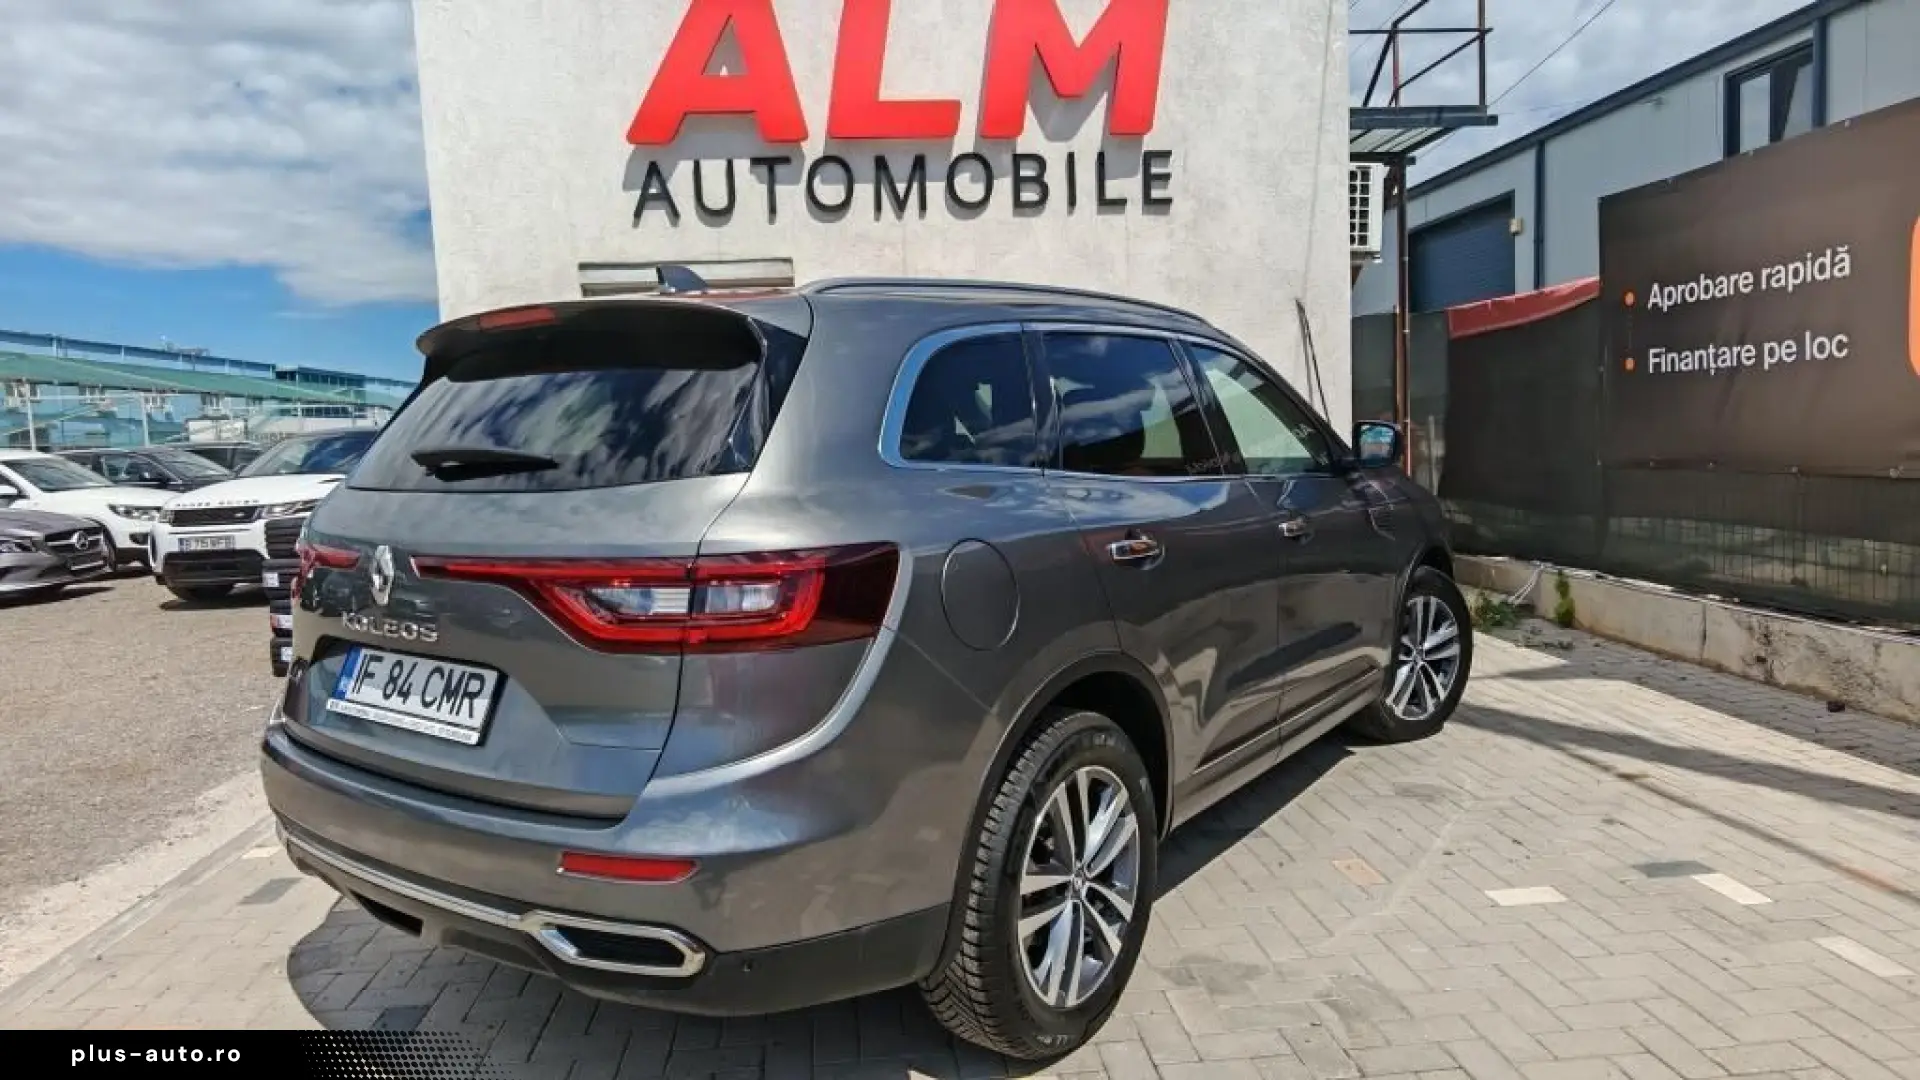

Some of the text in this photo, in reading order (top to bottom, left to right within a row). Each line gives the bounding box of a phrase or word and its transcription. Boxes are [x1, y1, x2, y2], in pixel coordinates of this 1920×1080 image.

[626, 0, 1169, 144] ALM
[633, 150, 1173, 221] AUTOMOBILE
[1647, 245, 1852, 312] Aprobare rapidă
[1648, 331, 1849, 376] Finanțare pe loc
[342, 611, 438, 642] KOLEOS
[352, 653, 485, 719] IF 84 CMR
